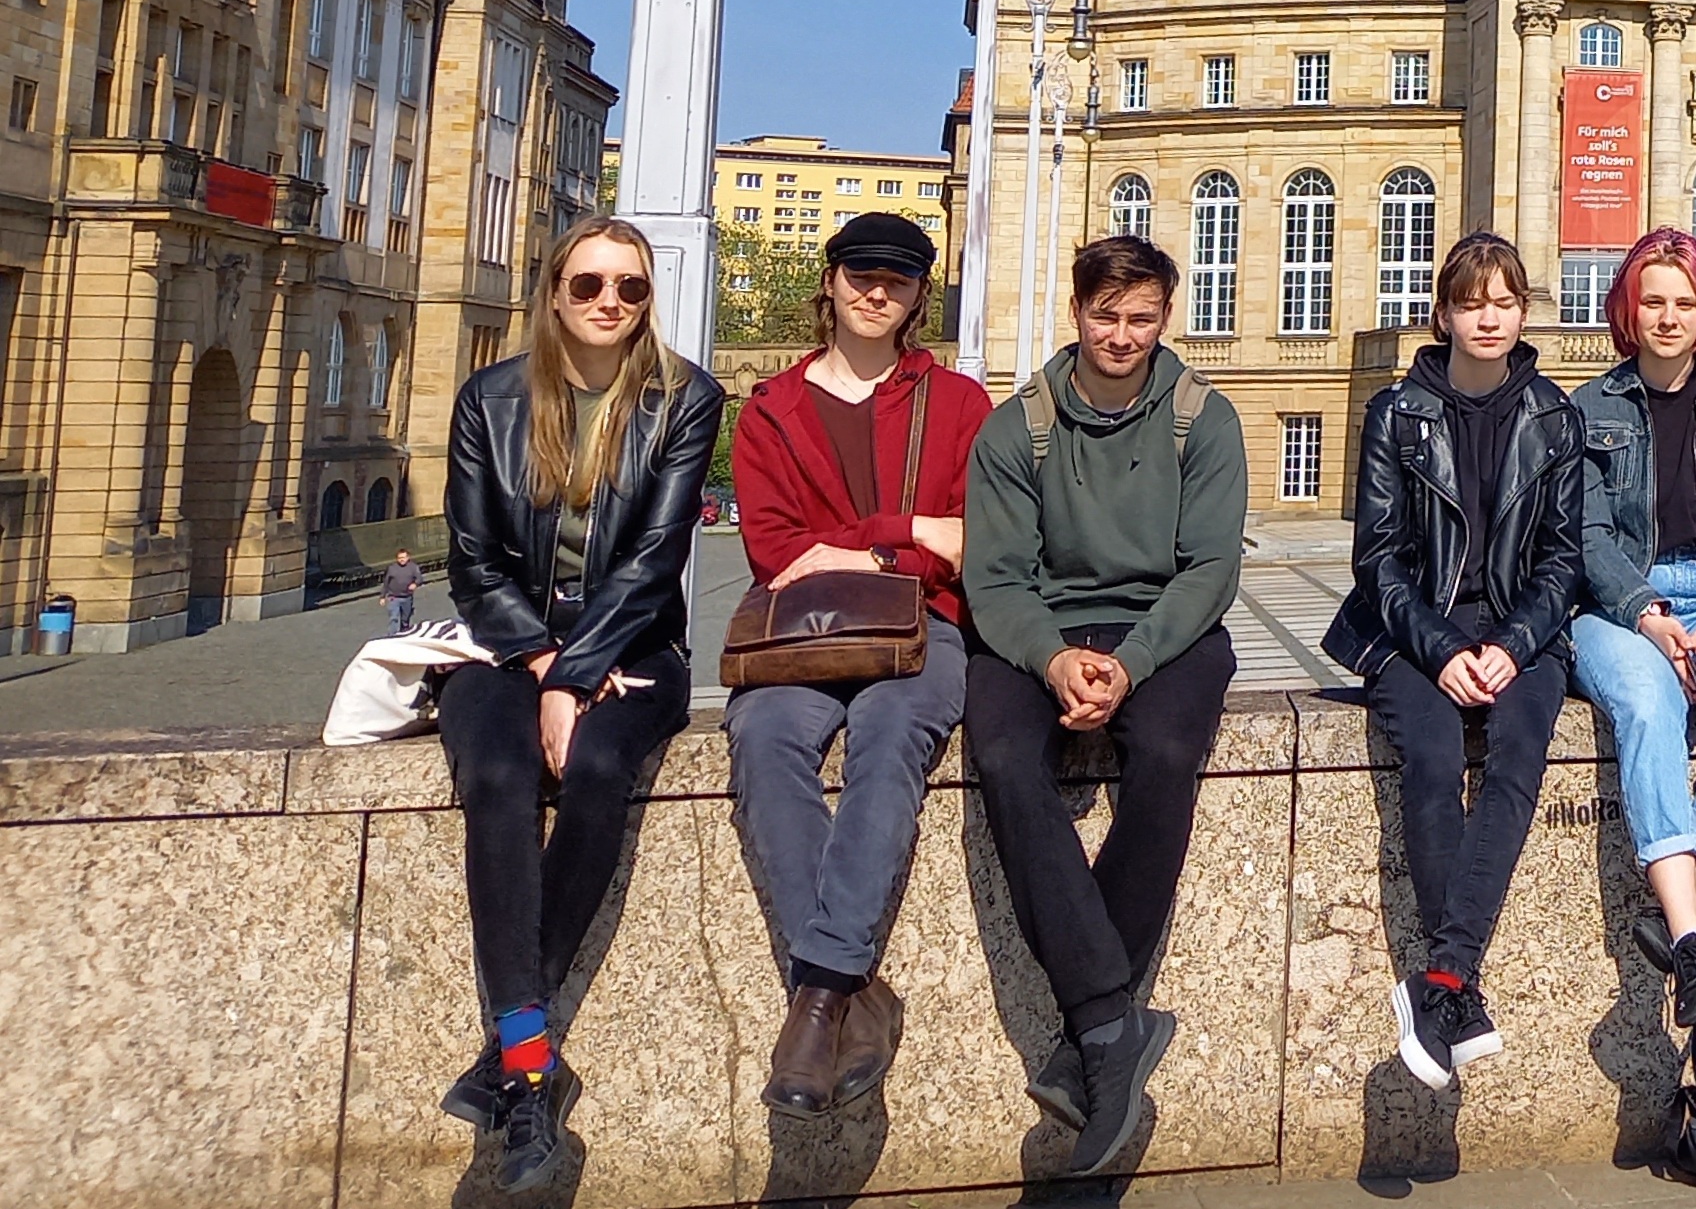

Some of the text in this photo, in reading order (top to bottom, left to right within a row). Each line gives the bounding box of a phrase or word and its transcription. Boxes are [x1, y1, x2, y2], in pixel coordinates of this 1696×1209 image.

[1577, 125, 1629, 138] Für mich
[1588, 140, 1618, 152] soll's
[1598, 154, 1634, 167] Rosen
[1581, 170, 1623, 182] regnen
